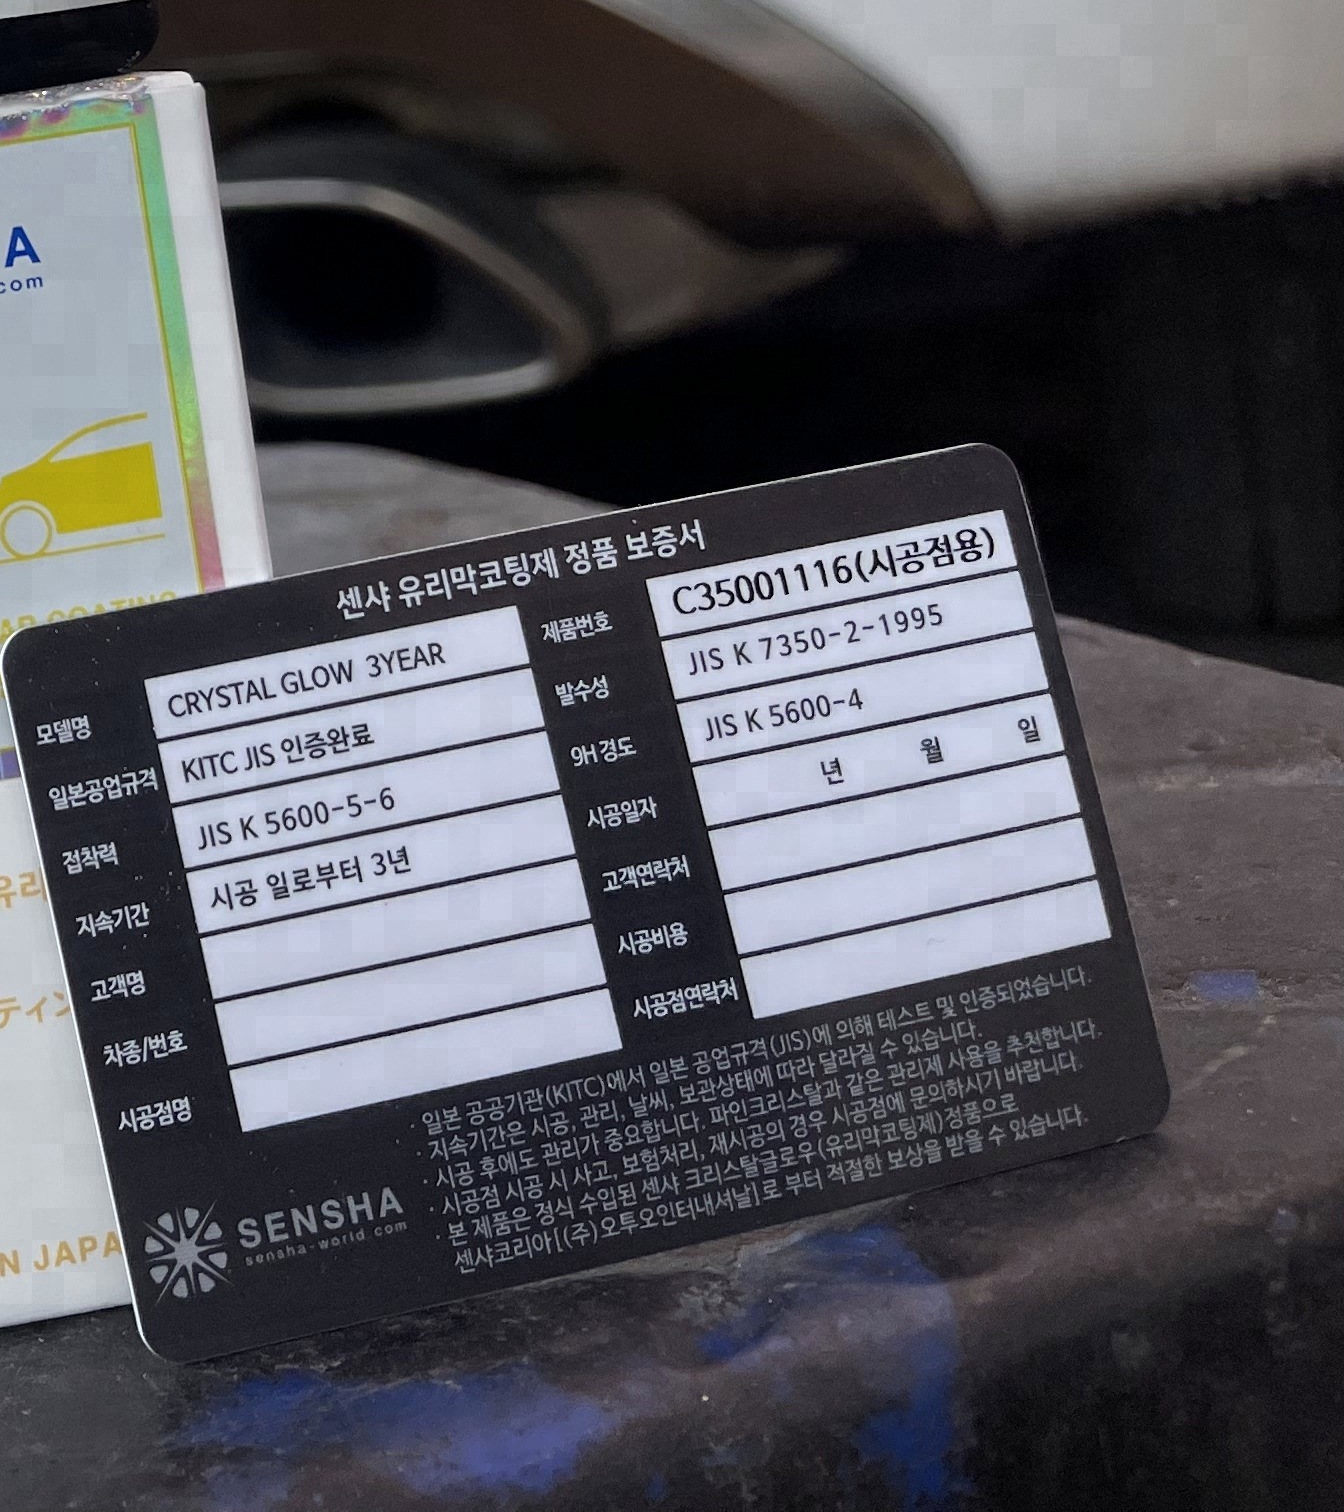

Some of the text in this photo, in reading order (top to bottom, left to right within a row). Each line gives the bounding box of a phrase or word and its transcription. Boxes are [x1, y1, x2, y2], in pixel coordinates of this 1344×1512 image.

[337, 519, 707, 622] 센샤 유리막코팅제 정품 보증서
[673, 526, 996, 616] C35001116(시공점용)
[541, 612, 613, 645] 제품번호
[689, 604, 944, 677] JIS K 7350-2-1995
[168, 643, 446, 719] CRYSTAL GLOW 3YEAR
[555, 675, 609, 707] 발수성
[36, 715, 92, 746] 모델명
[704, 688, 863, 743] JIS K 5600-4
[182, 723, 375, 783] KITC JIS 인증완료
[571, 735, 636, 767] 9H 경도
[820, 716, 1040, 786] 년 월 일
[48, 767, 158, 811] 일본공업규격
[587, 797, 657, 831] 시공일자
[197, 788, 396, 851] JIS K 5600-5-6
[62, 843, 119, 875] 접착력
[211, 847, 411, 911] 시공 일로부터 3년
[601, 855, 690, 893] 고객연락처
[76, 903, 149, 938] 지속기간
[618, 922, 688, 956] 시공비용
[90, 970, 146, 1002] 고객명
[633, 977, 739, 1021] 시공점연락처
[103, 1031, 188, 1068] 차종/번호
[422, 1106, 461, 1136] 일본
[466, 1065, 645, 1126] 공공기관(KITC)에서
[650, 1056, 688, 1085] 일본
[693, 1023, 832, 1075] 공업규격(JIS)에
[837, 1015, 874, 1040] 의해
[877, 1002, 934, 1032] 테스트
[118, 1097, 193, 1133] 시공점명
[428, 1120, 526, 1161] 지속기간은
[532, 1111, 577, 1139] 시공,
[579, 1100, 625, 1129] 관리,
[680, 1064, 774, 1105] 보관상태에
[777, 1057, 815, 1082] 따라
[820, 1042, 876, 1075] 달라질
[902, 1019, 982, 1055] 있습니다.
[436, 1161, 474, 1188] 시공
[480, 1149, 539, 1179] 후에도
[541, 1134, 599, 1167] 관리가
[605, 1111, 706, 1152] 중요합니다.
[711, 1078, 841, 1126] 파인크리스탈과
[846, 1068, 883, 1097] 같은
[887, 1054, 943, 1087] 관리제
[948, 1041, 1002, 1070] 사용을
[442, 1050, 1083, 1216] 시공점 시공 사고, 보험처리, 재시공의 경우 시공점에 문의하시기 바랍니다.
[827, 1104, 1088, 1185] 적절한 보상을 받을 있습니다.
[237, 1186, 403, 1248] SENSHA
[448, 1172, 679, 1246] 본 제품은 정식 수입된 센샤
[34, 1231, 123, 1271] JAPA
